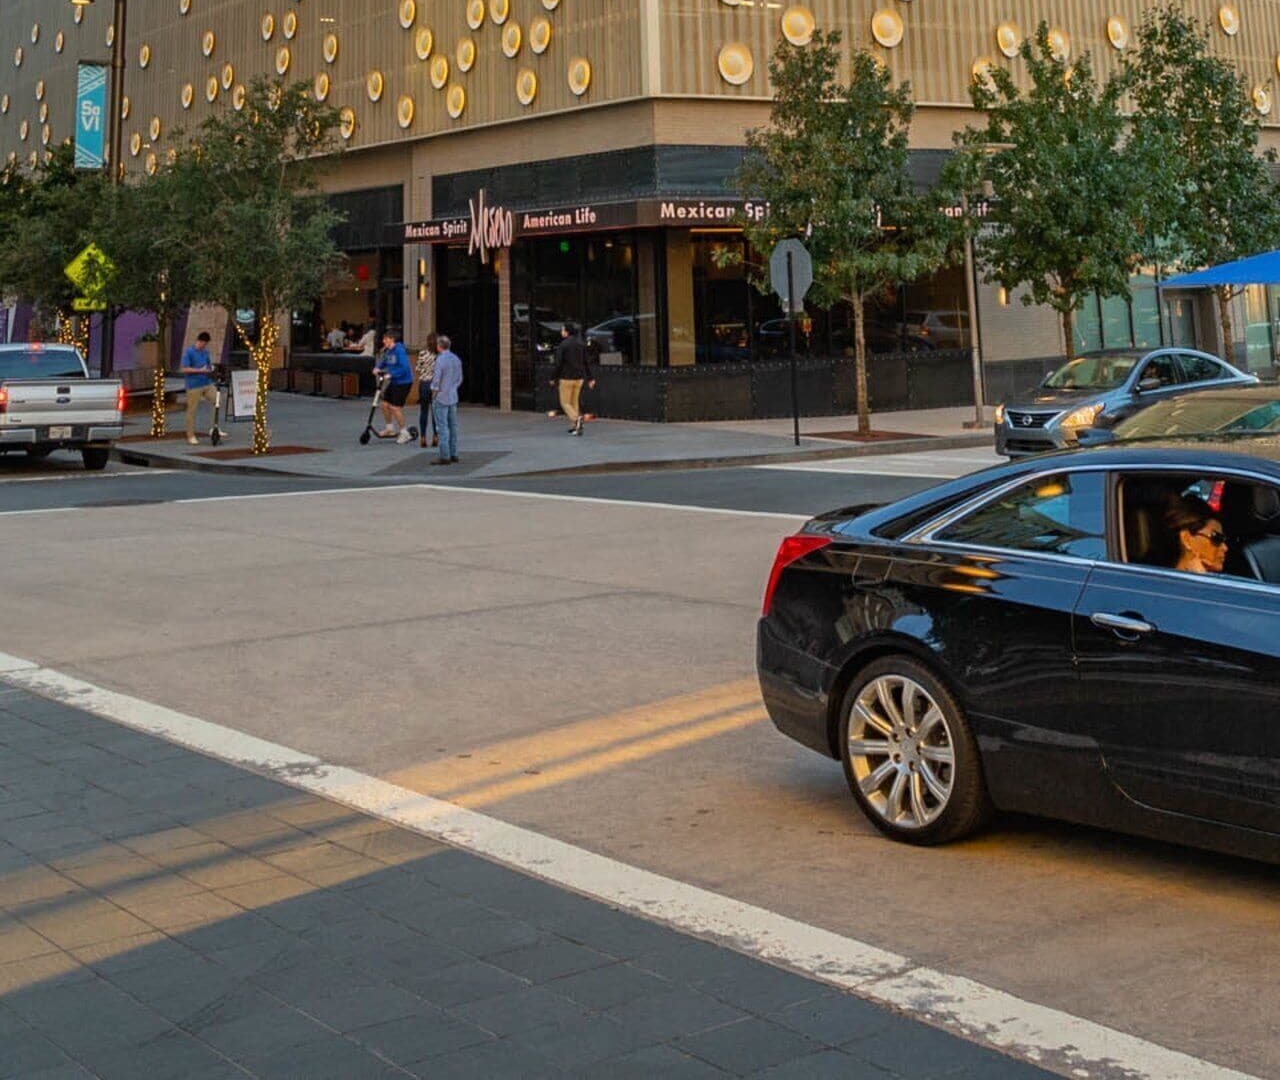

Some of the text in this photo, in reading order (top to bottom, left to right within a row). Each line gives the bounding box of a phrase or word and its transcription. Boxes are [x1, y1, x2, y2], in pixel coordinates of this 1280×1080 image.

[661, 202, 735, 218] Mexican
[405, 223, 441, 238] Mexican
[442, 220, 468, 238] Spirit
[523, 211, 572, 228] American
[575, 207, 597, 223] Life
